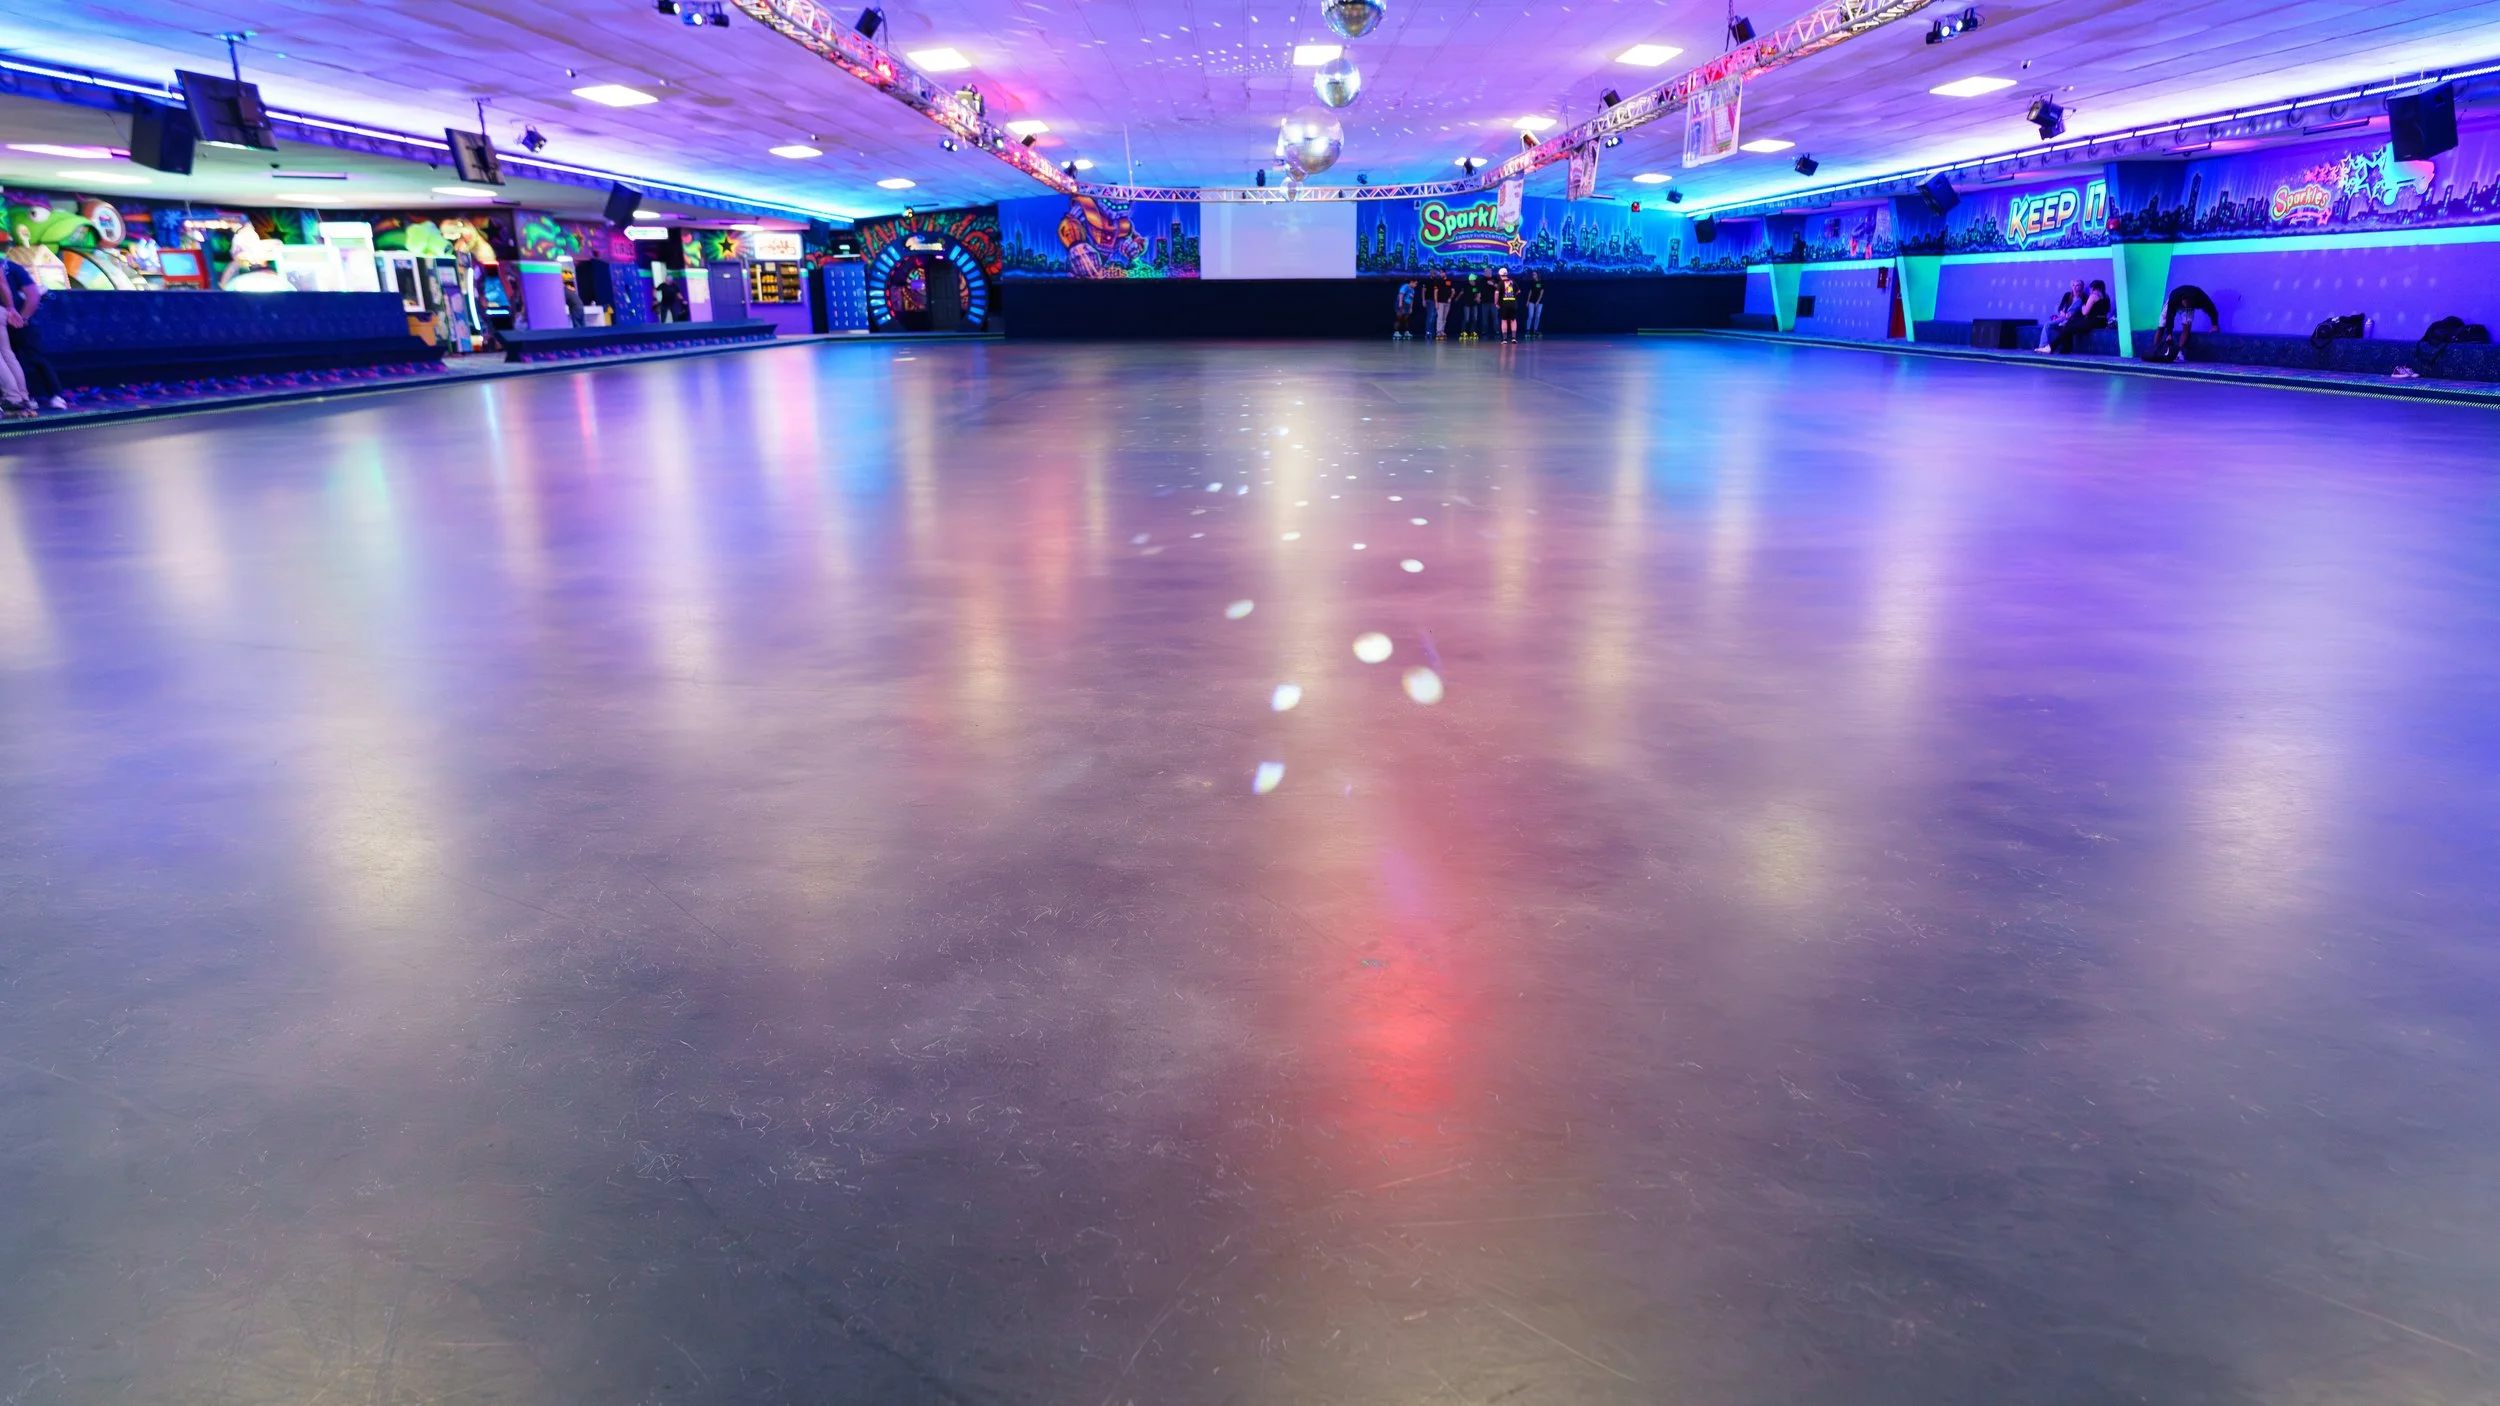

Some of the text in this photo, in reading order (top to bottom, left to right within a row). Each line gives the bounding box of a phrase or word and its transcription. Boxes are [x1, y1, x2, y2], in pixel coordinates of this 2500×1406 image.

[2008, 191, 2077, 243] KEEP
[2272, 185, 2329, 218] Sparkles
[1424, 203, 1515, 242] Sparkl
